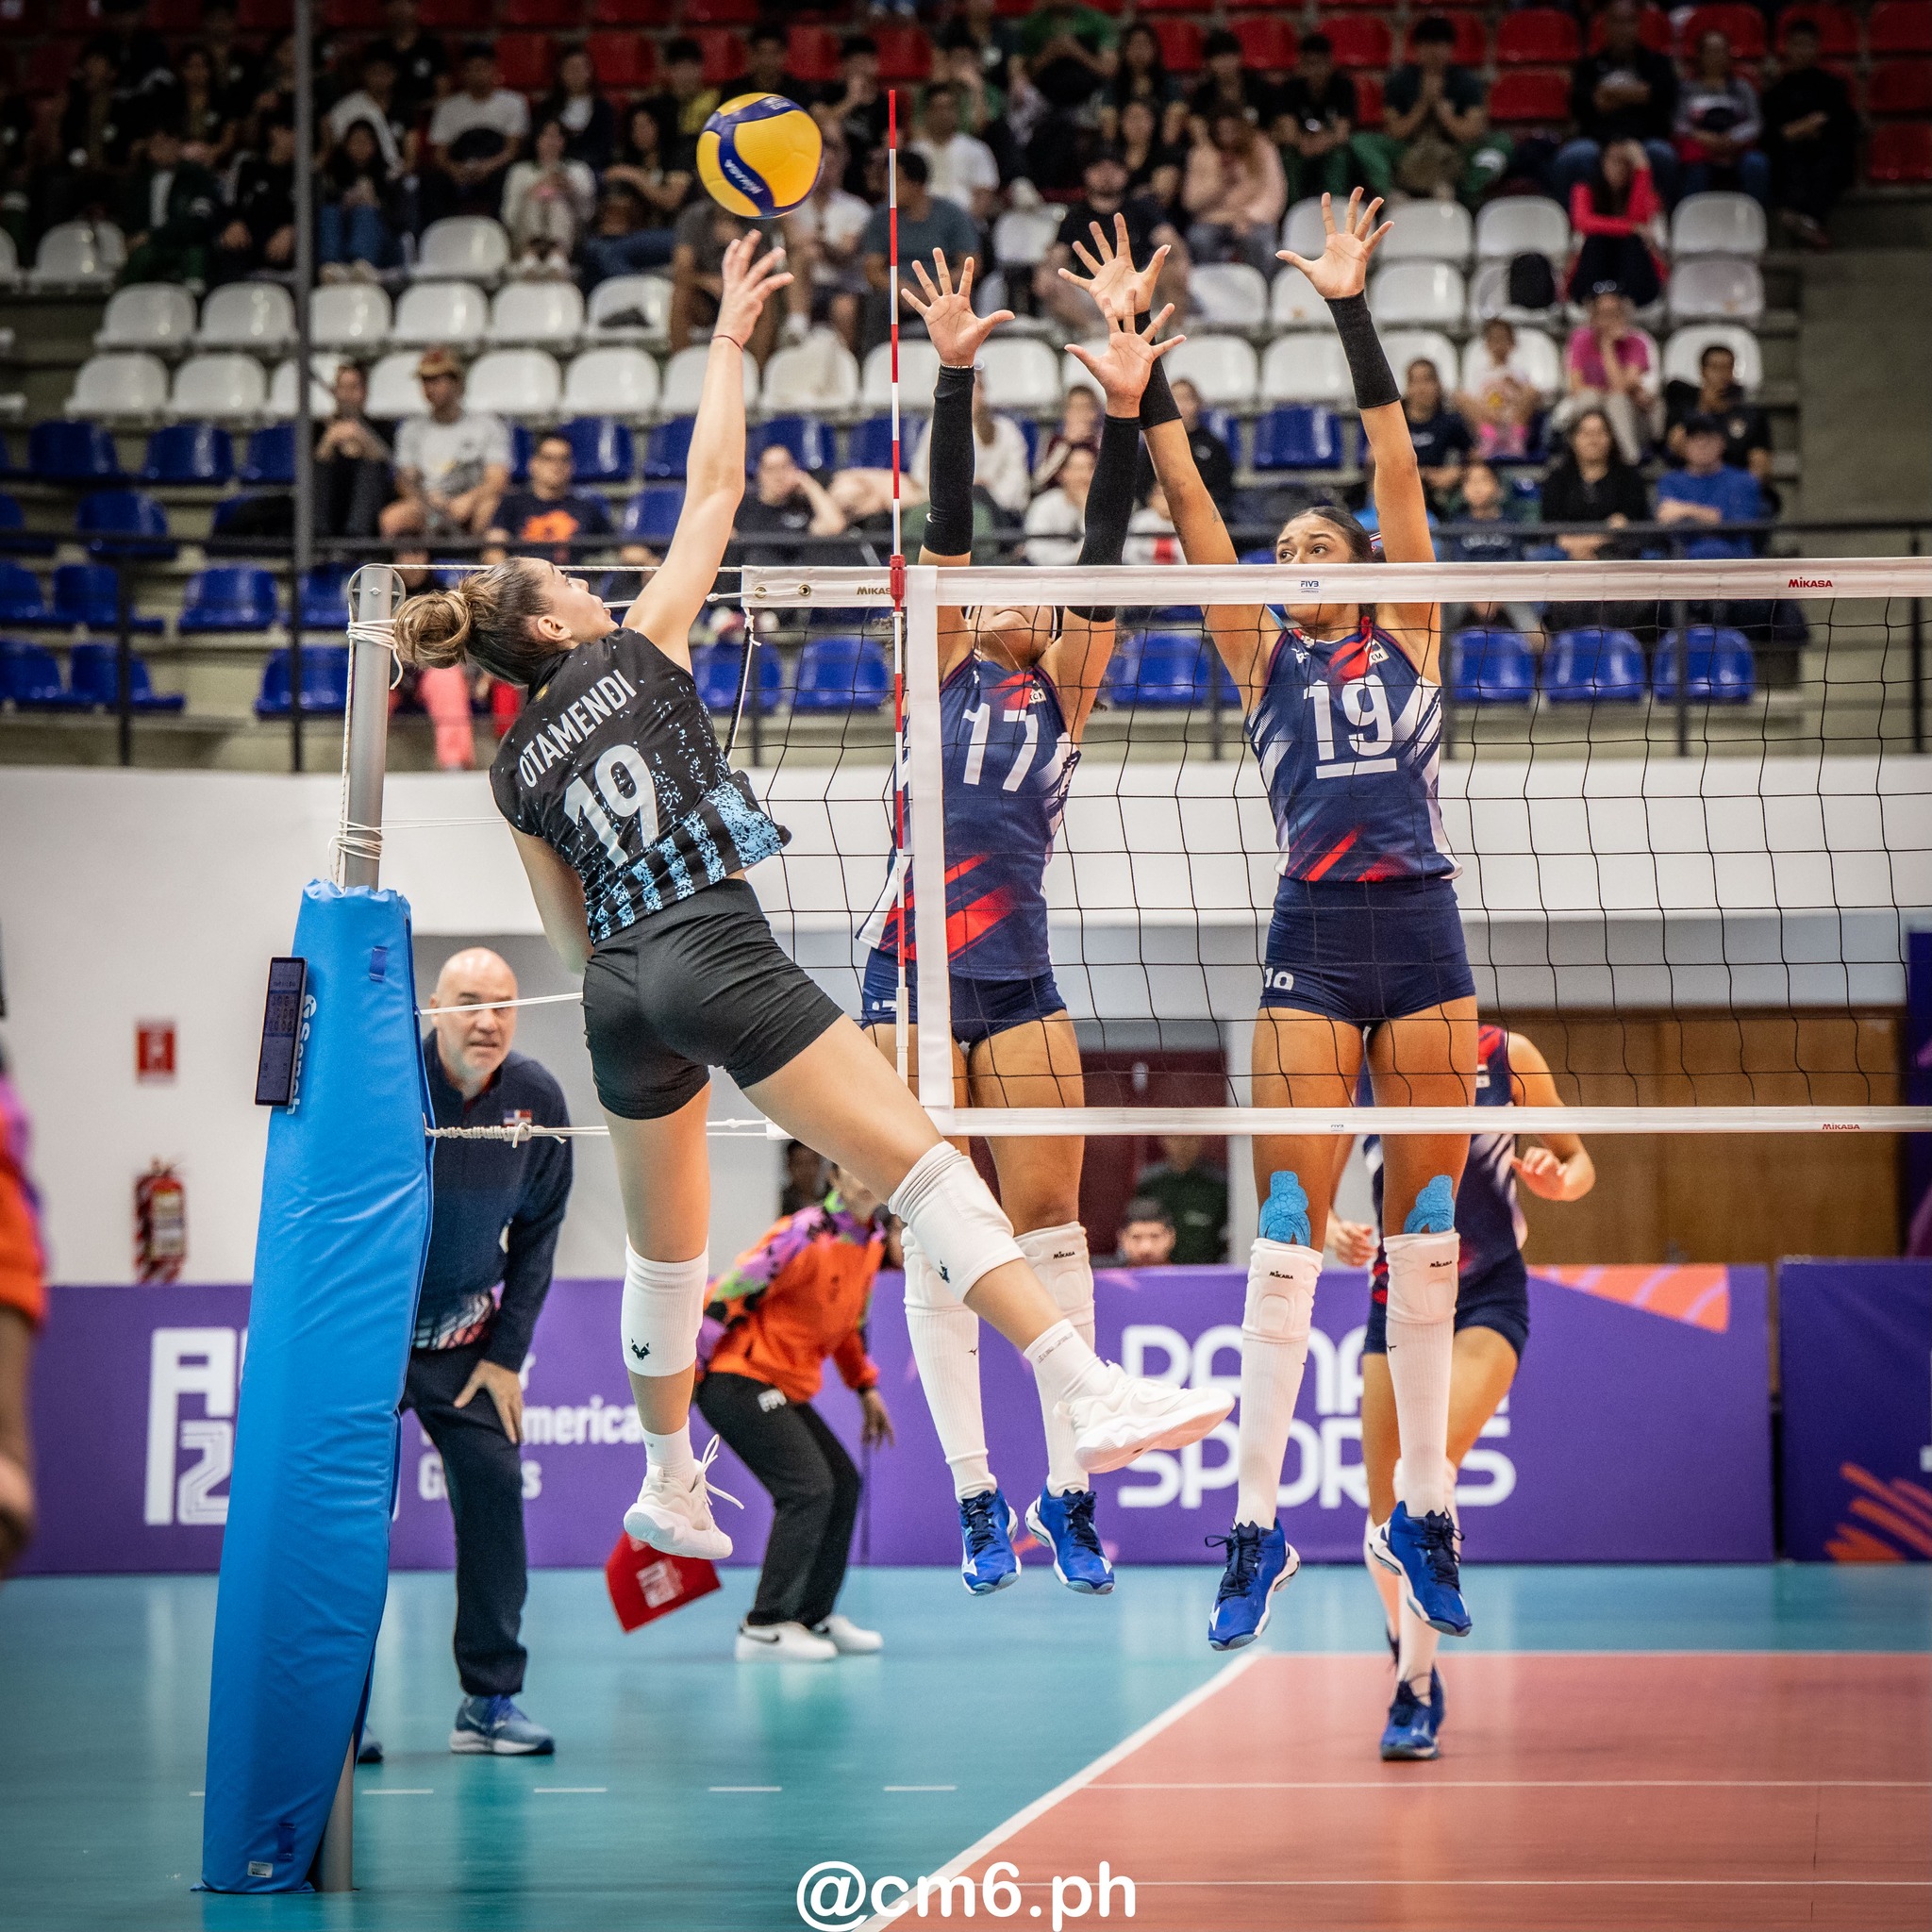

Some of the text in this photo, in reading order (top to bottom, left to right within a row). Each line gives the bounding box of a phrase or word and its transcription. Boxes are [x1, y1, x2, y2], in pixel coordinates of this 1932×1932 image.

[857, 586, 891, 595] MIKAS
[519, 669, 638, 788] OTAMENDI
[962, 702, 1039, 792] 17
[1303, 674, 1393, 761] 19
[564, 743, 659, 868] 19
